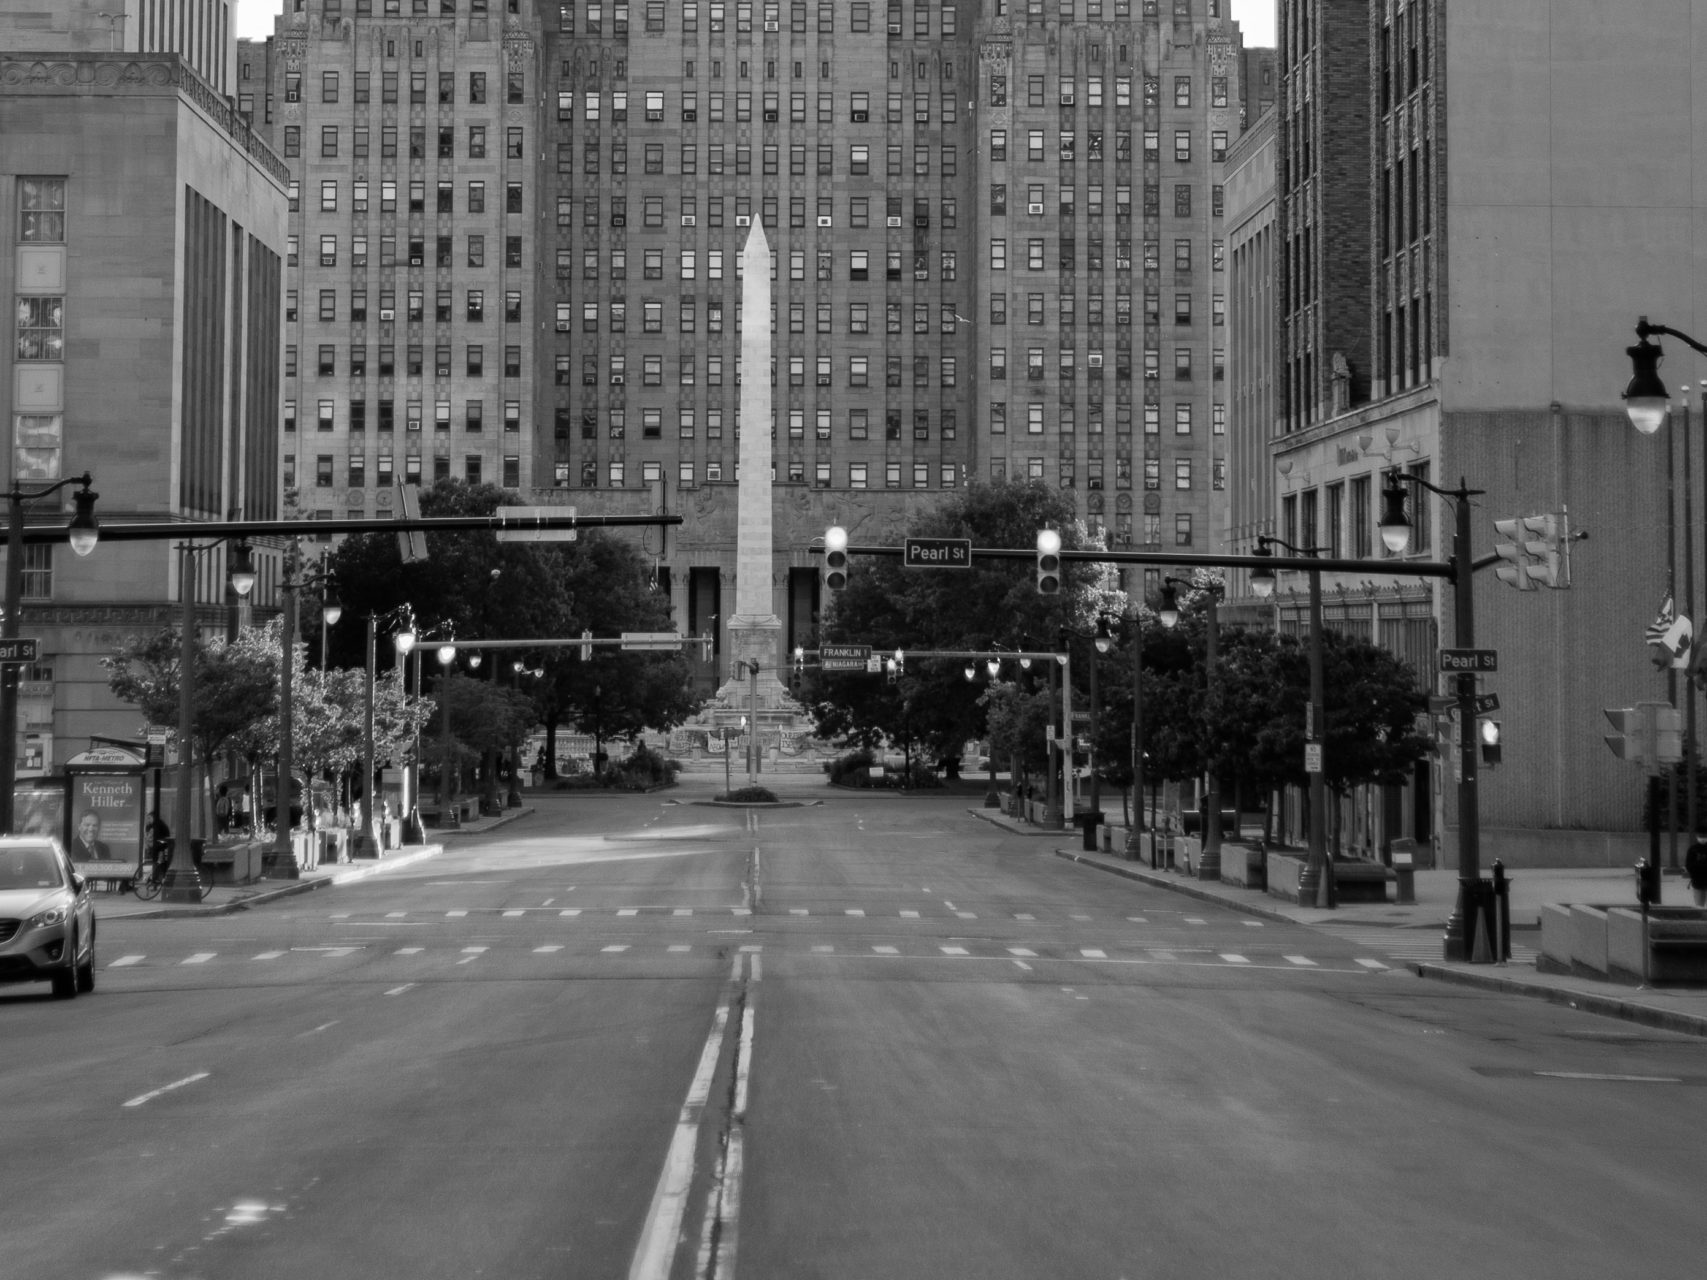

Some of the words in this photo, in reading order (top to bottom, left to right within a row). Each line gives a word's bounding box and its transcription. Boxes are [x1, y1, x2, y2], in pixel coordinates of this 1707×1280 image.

[911, 545, 948, 560] Pearl
[953, 547, 964, 559] St
[0, 645, 17, 658] arl
[22, 645, 34, 656] St
[823, 648, 861, 657] FRANKLIN
[1442, 654, 1478, 668] Pearl
[1483, 655, 1495, 666] St
[1484, 698, 1495, 708] St
[82, 782, 133, 794] Kenneth
[91, 796, 125, 808] Hiller
